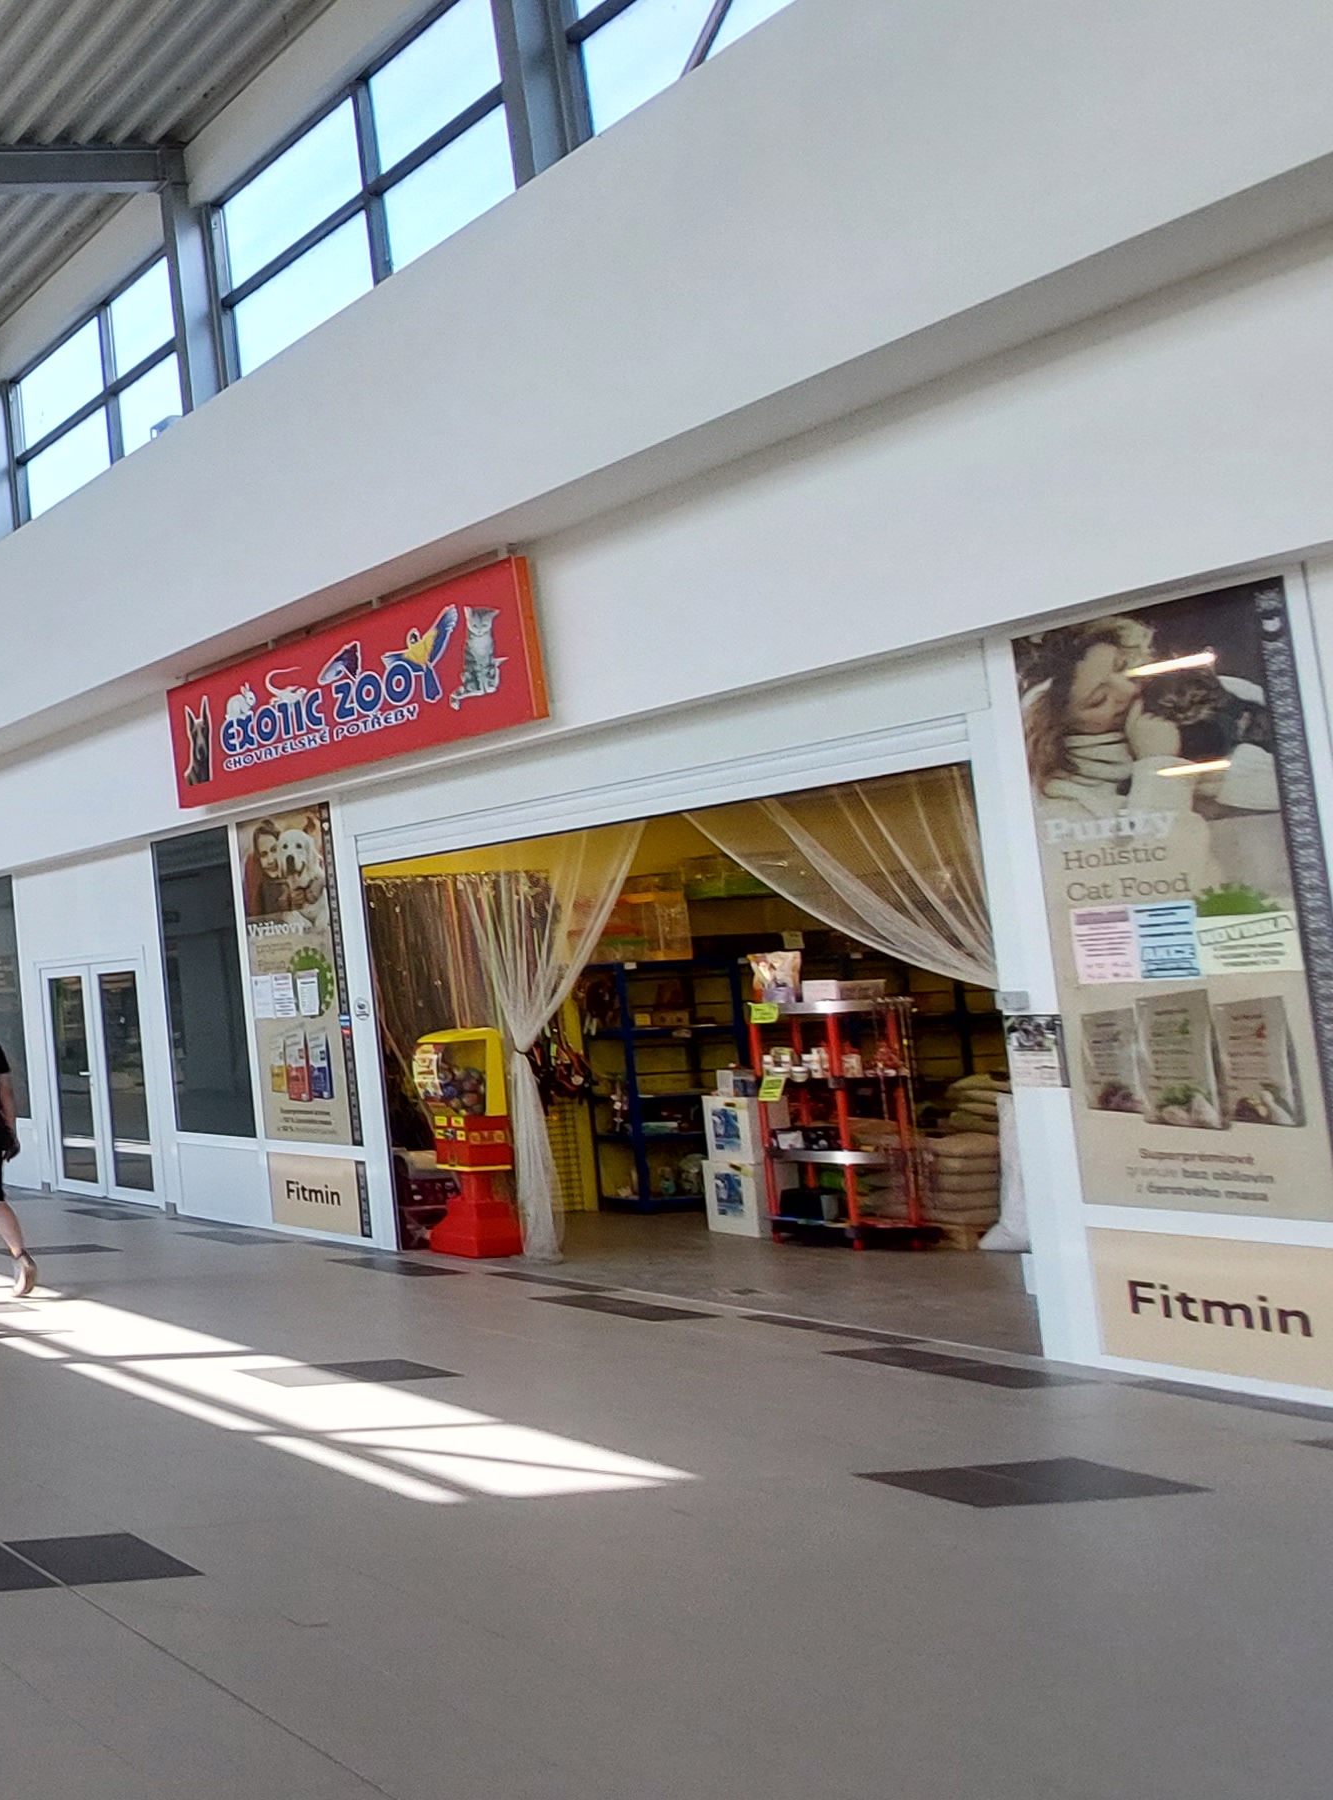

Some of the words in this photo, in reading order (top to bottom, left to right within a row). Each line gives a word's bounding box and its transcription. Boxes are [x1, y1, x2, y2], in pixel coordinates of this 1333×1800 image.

[222, 689, 323, 753] EXOTIC
[333, 662, 415, 721] ZOO
[224, 726, 329, 769] CHOVATELSKÉ
[335, 704, 418, 741] POTŘEBY
[1063, 846, 1167, 871] Holistic
[1066, 880, 1113, 902] Cat
[1119, 873, 1191, 898] Food
[285, 1180, 341, 1206] Fitmin
[1127, 1279, 1313, 1338] Fitmin
